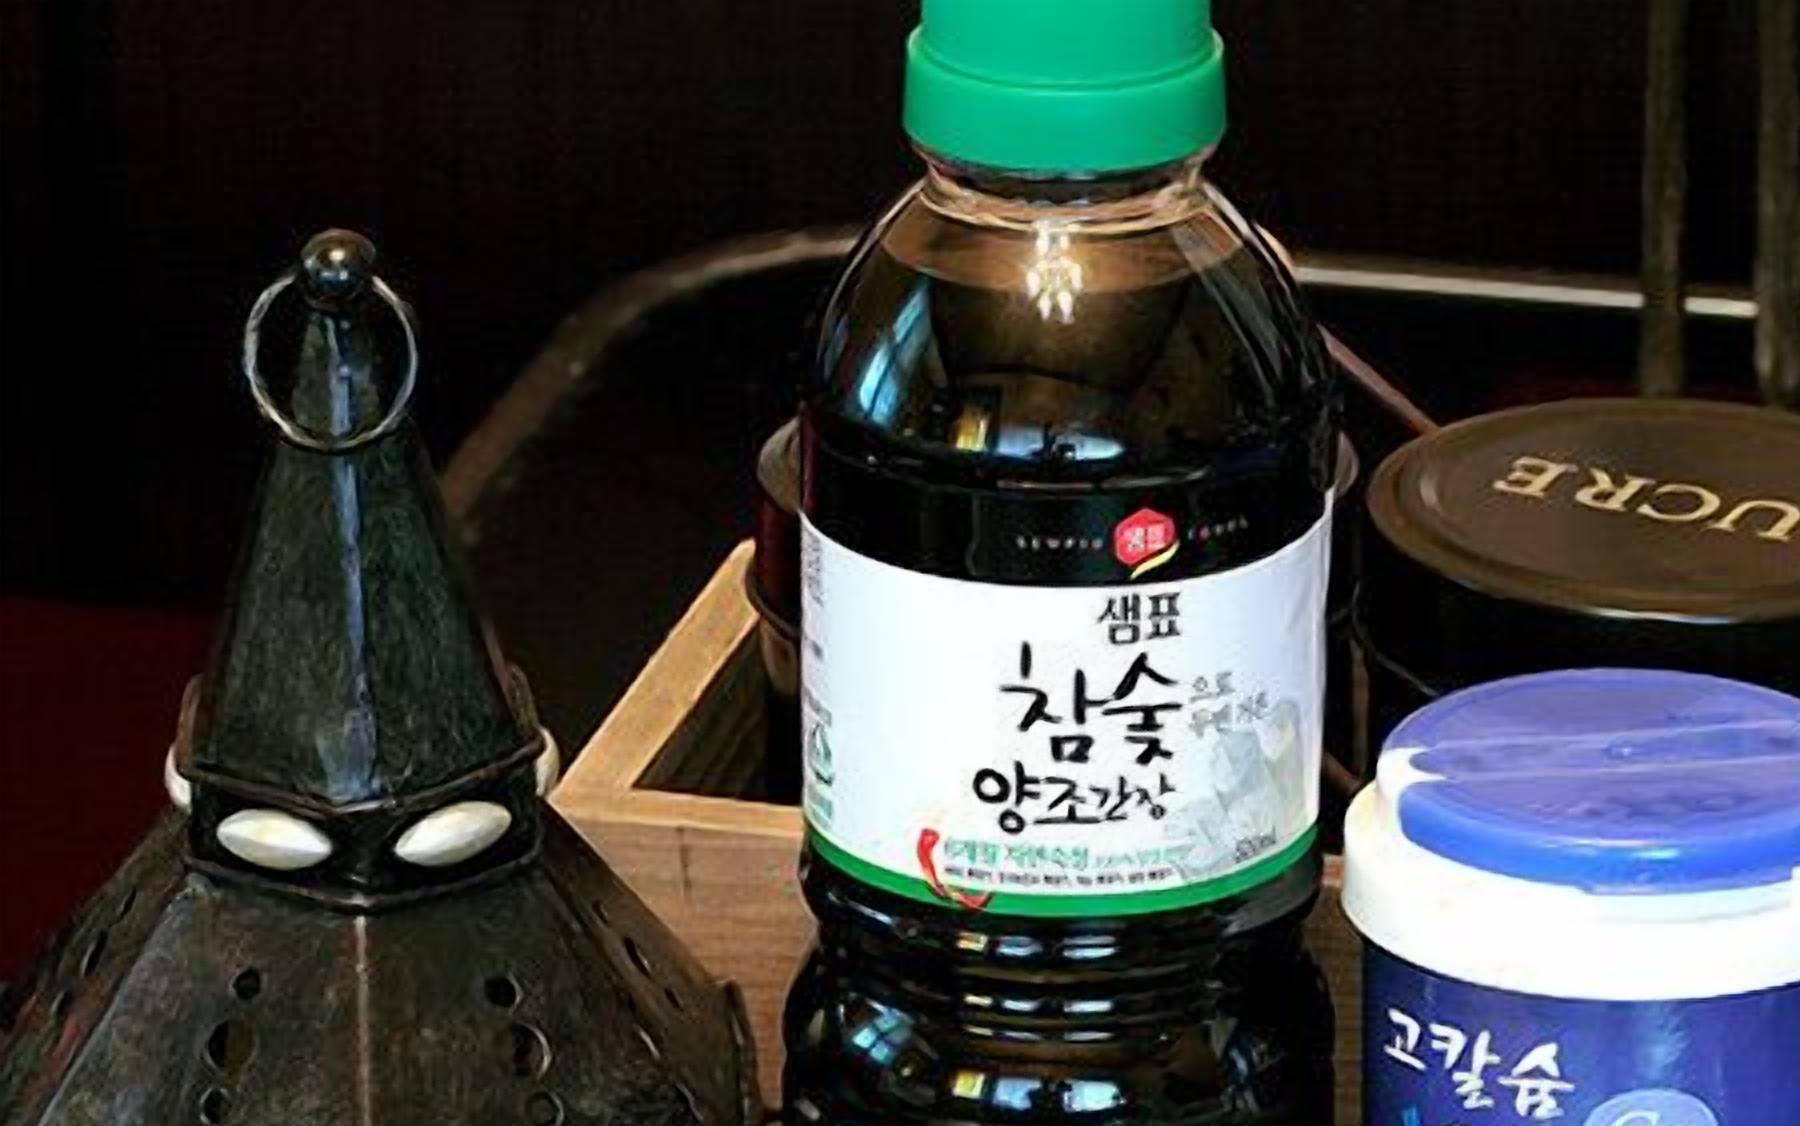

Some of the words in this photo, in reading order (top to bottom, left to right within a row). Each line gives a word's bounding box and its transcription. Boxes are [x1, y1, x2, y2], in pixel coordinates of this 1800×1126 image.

[1097, 592, 1182, 644] 샘표
[973, 761, 1176, 833] 양조간장
[1384, 1008, 1575, 1120] 고칼슘
